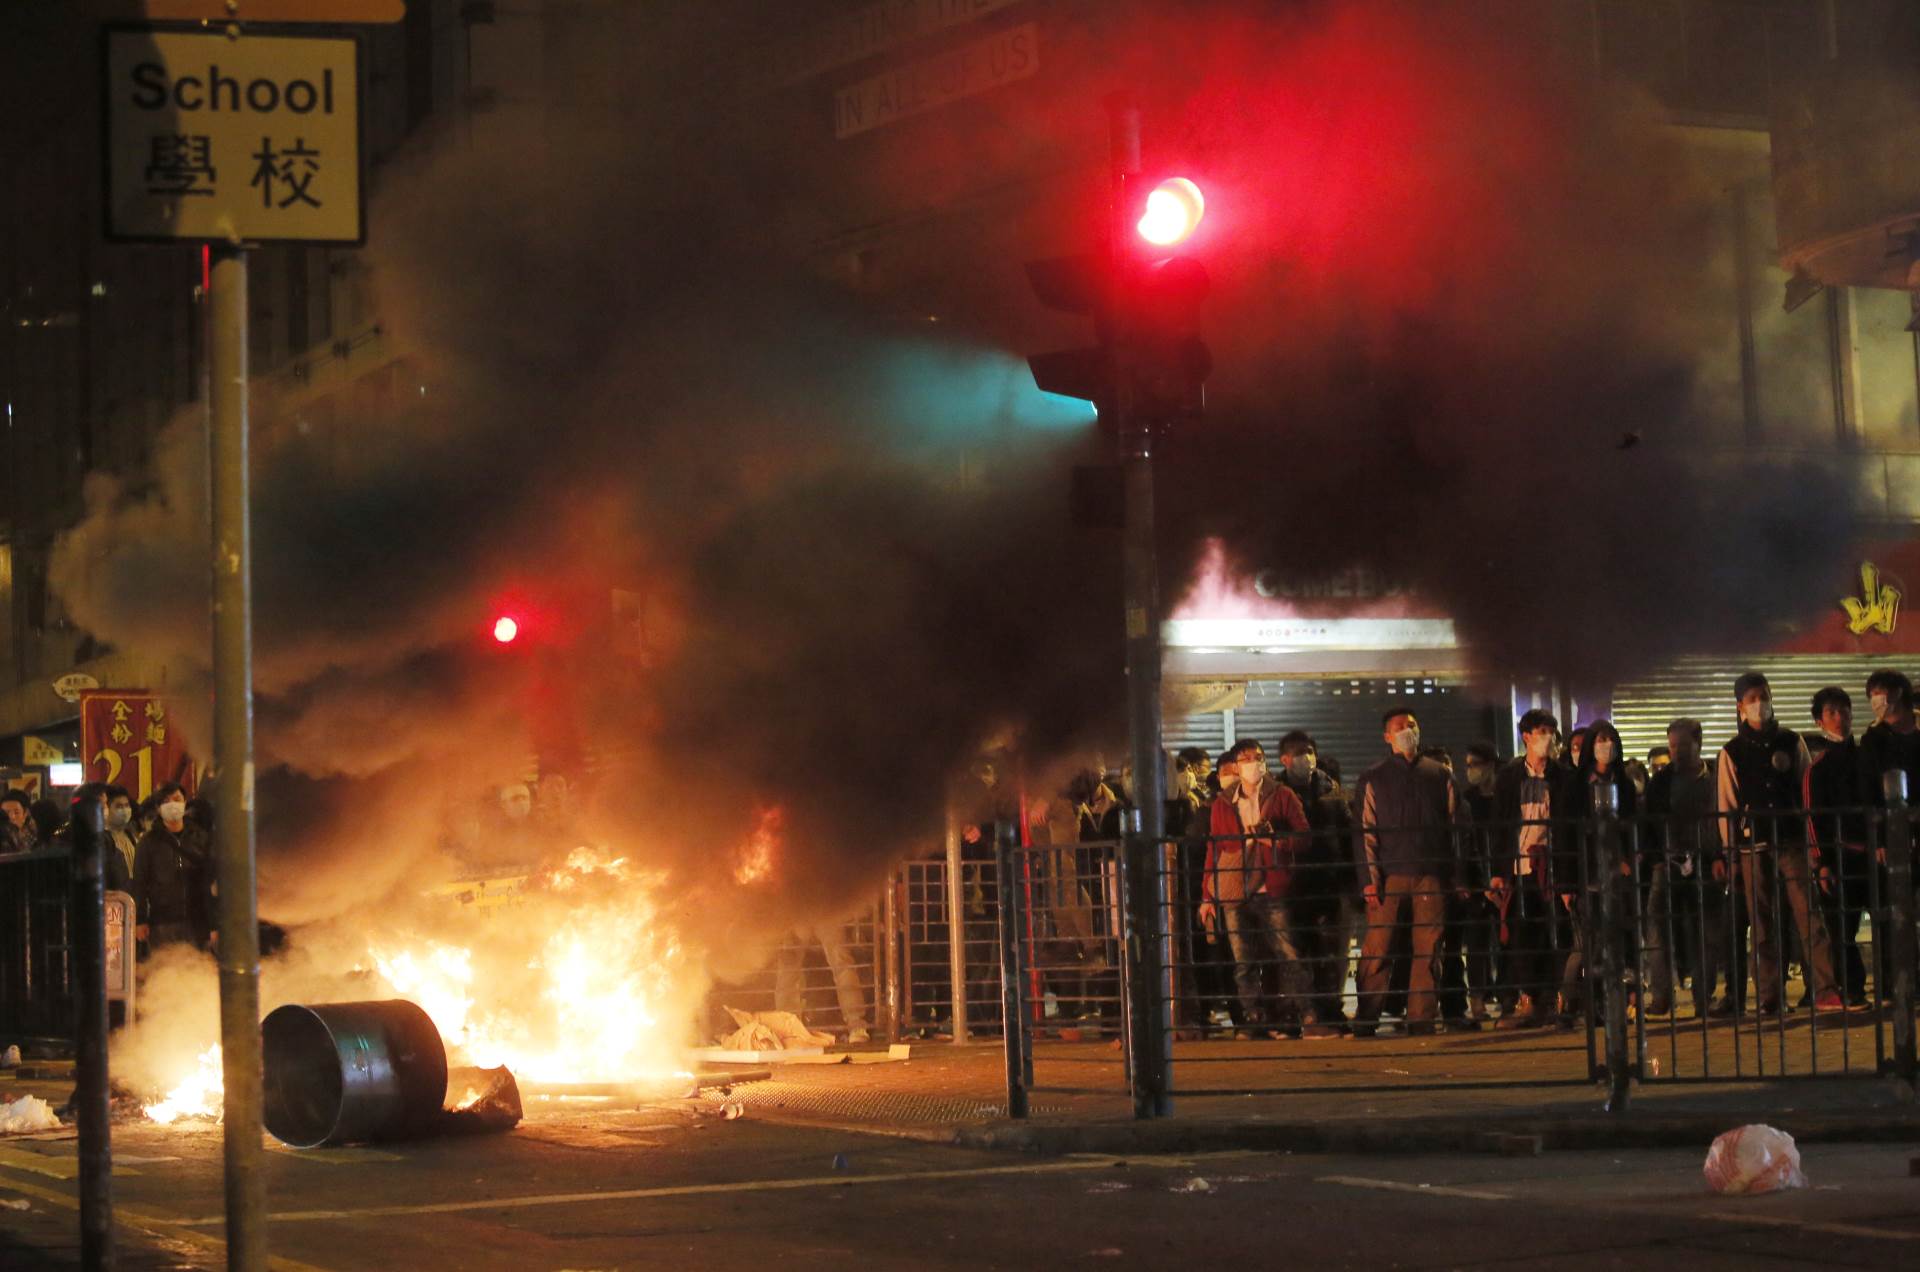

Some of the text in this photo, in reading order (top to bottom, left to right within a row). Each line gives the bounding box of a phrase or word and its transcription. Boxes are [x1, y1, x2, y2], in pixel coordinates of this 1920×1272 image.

[989, 34, 1029, 77] US
[131, 62, 334, 114] School
[145, 135, 322, 209] 學校
